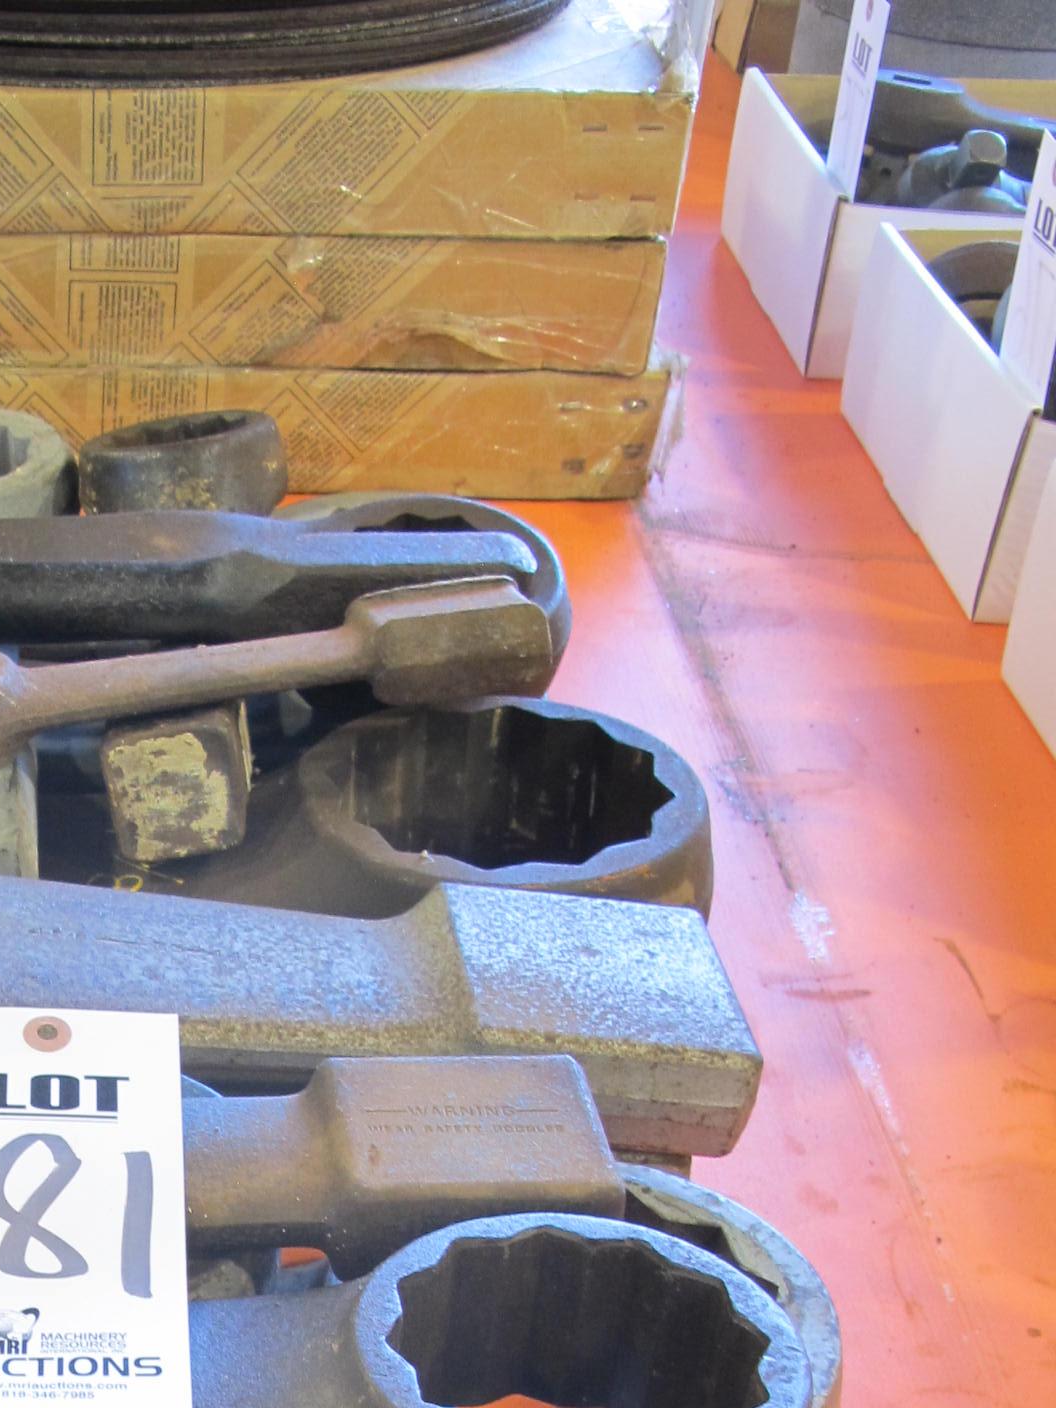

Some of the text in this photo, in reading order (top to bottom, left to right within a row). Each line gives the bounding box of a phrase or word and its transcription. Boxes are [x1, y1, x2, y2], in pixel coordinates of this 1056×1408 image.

[407, 1104, 518, 1117] WARNING
[40, 1332, 128, 1341] MACHINERY
[40, 1341, 127, 1349] RESOURCES
